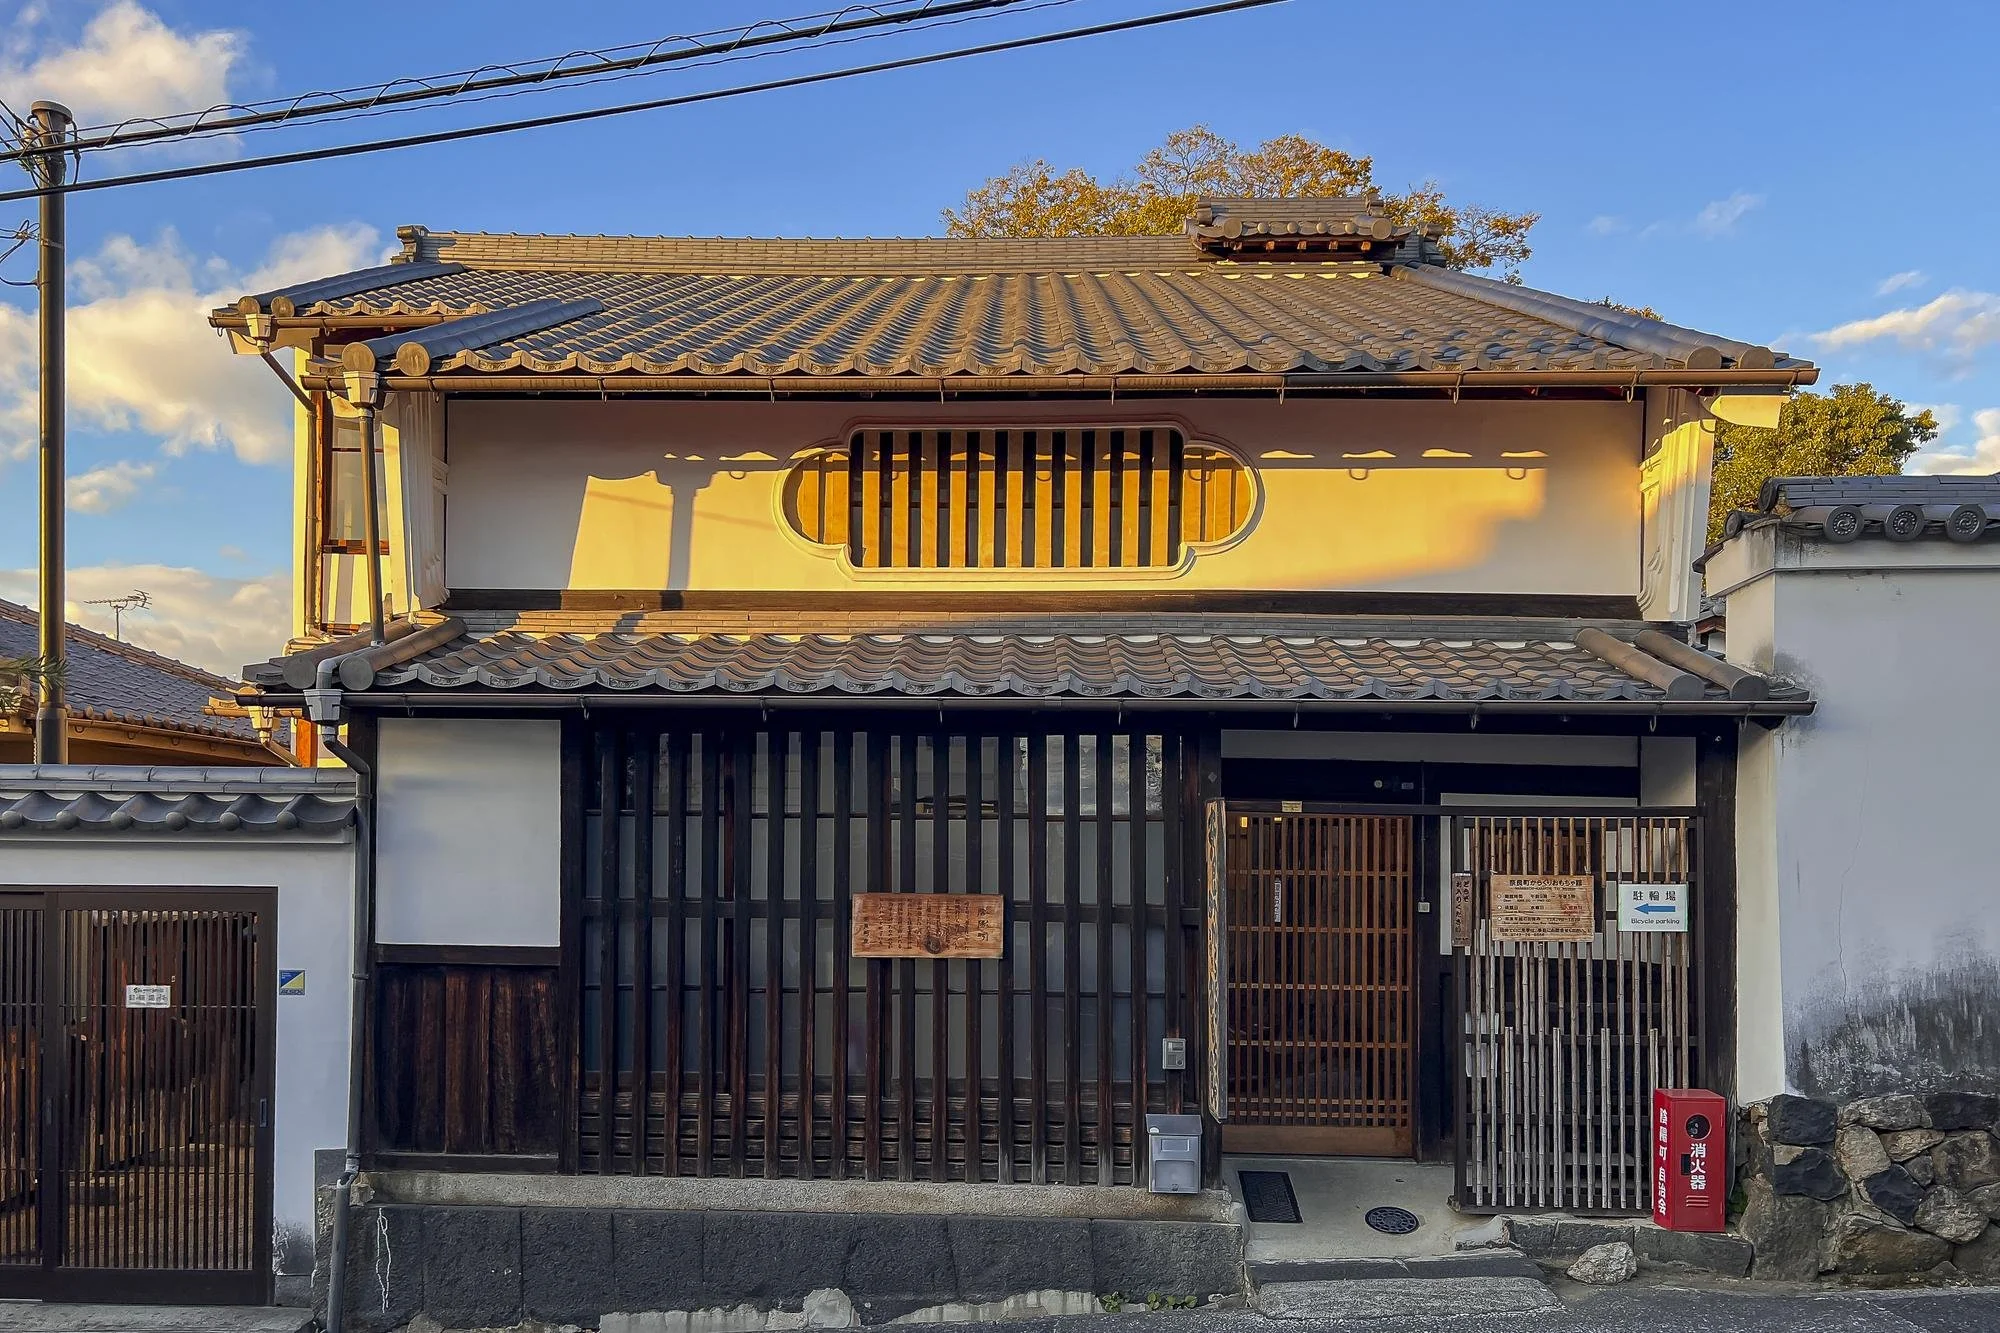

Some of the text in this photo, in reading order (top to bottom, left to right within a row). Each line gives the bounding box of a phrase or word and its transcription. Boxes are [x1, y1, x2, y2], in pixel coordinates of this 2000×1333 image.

[1509, 879, 1583, 887] 奈良町からくりおもちゃ館
[1632, 890, 1676, 901] 駐輪場
[1690, 1142, 1707, 1190] 消火器
[1658, 1166, 1667, 1216] 自治会
